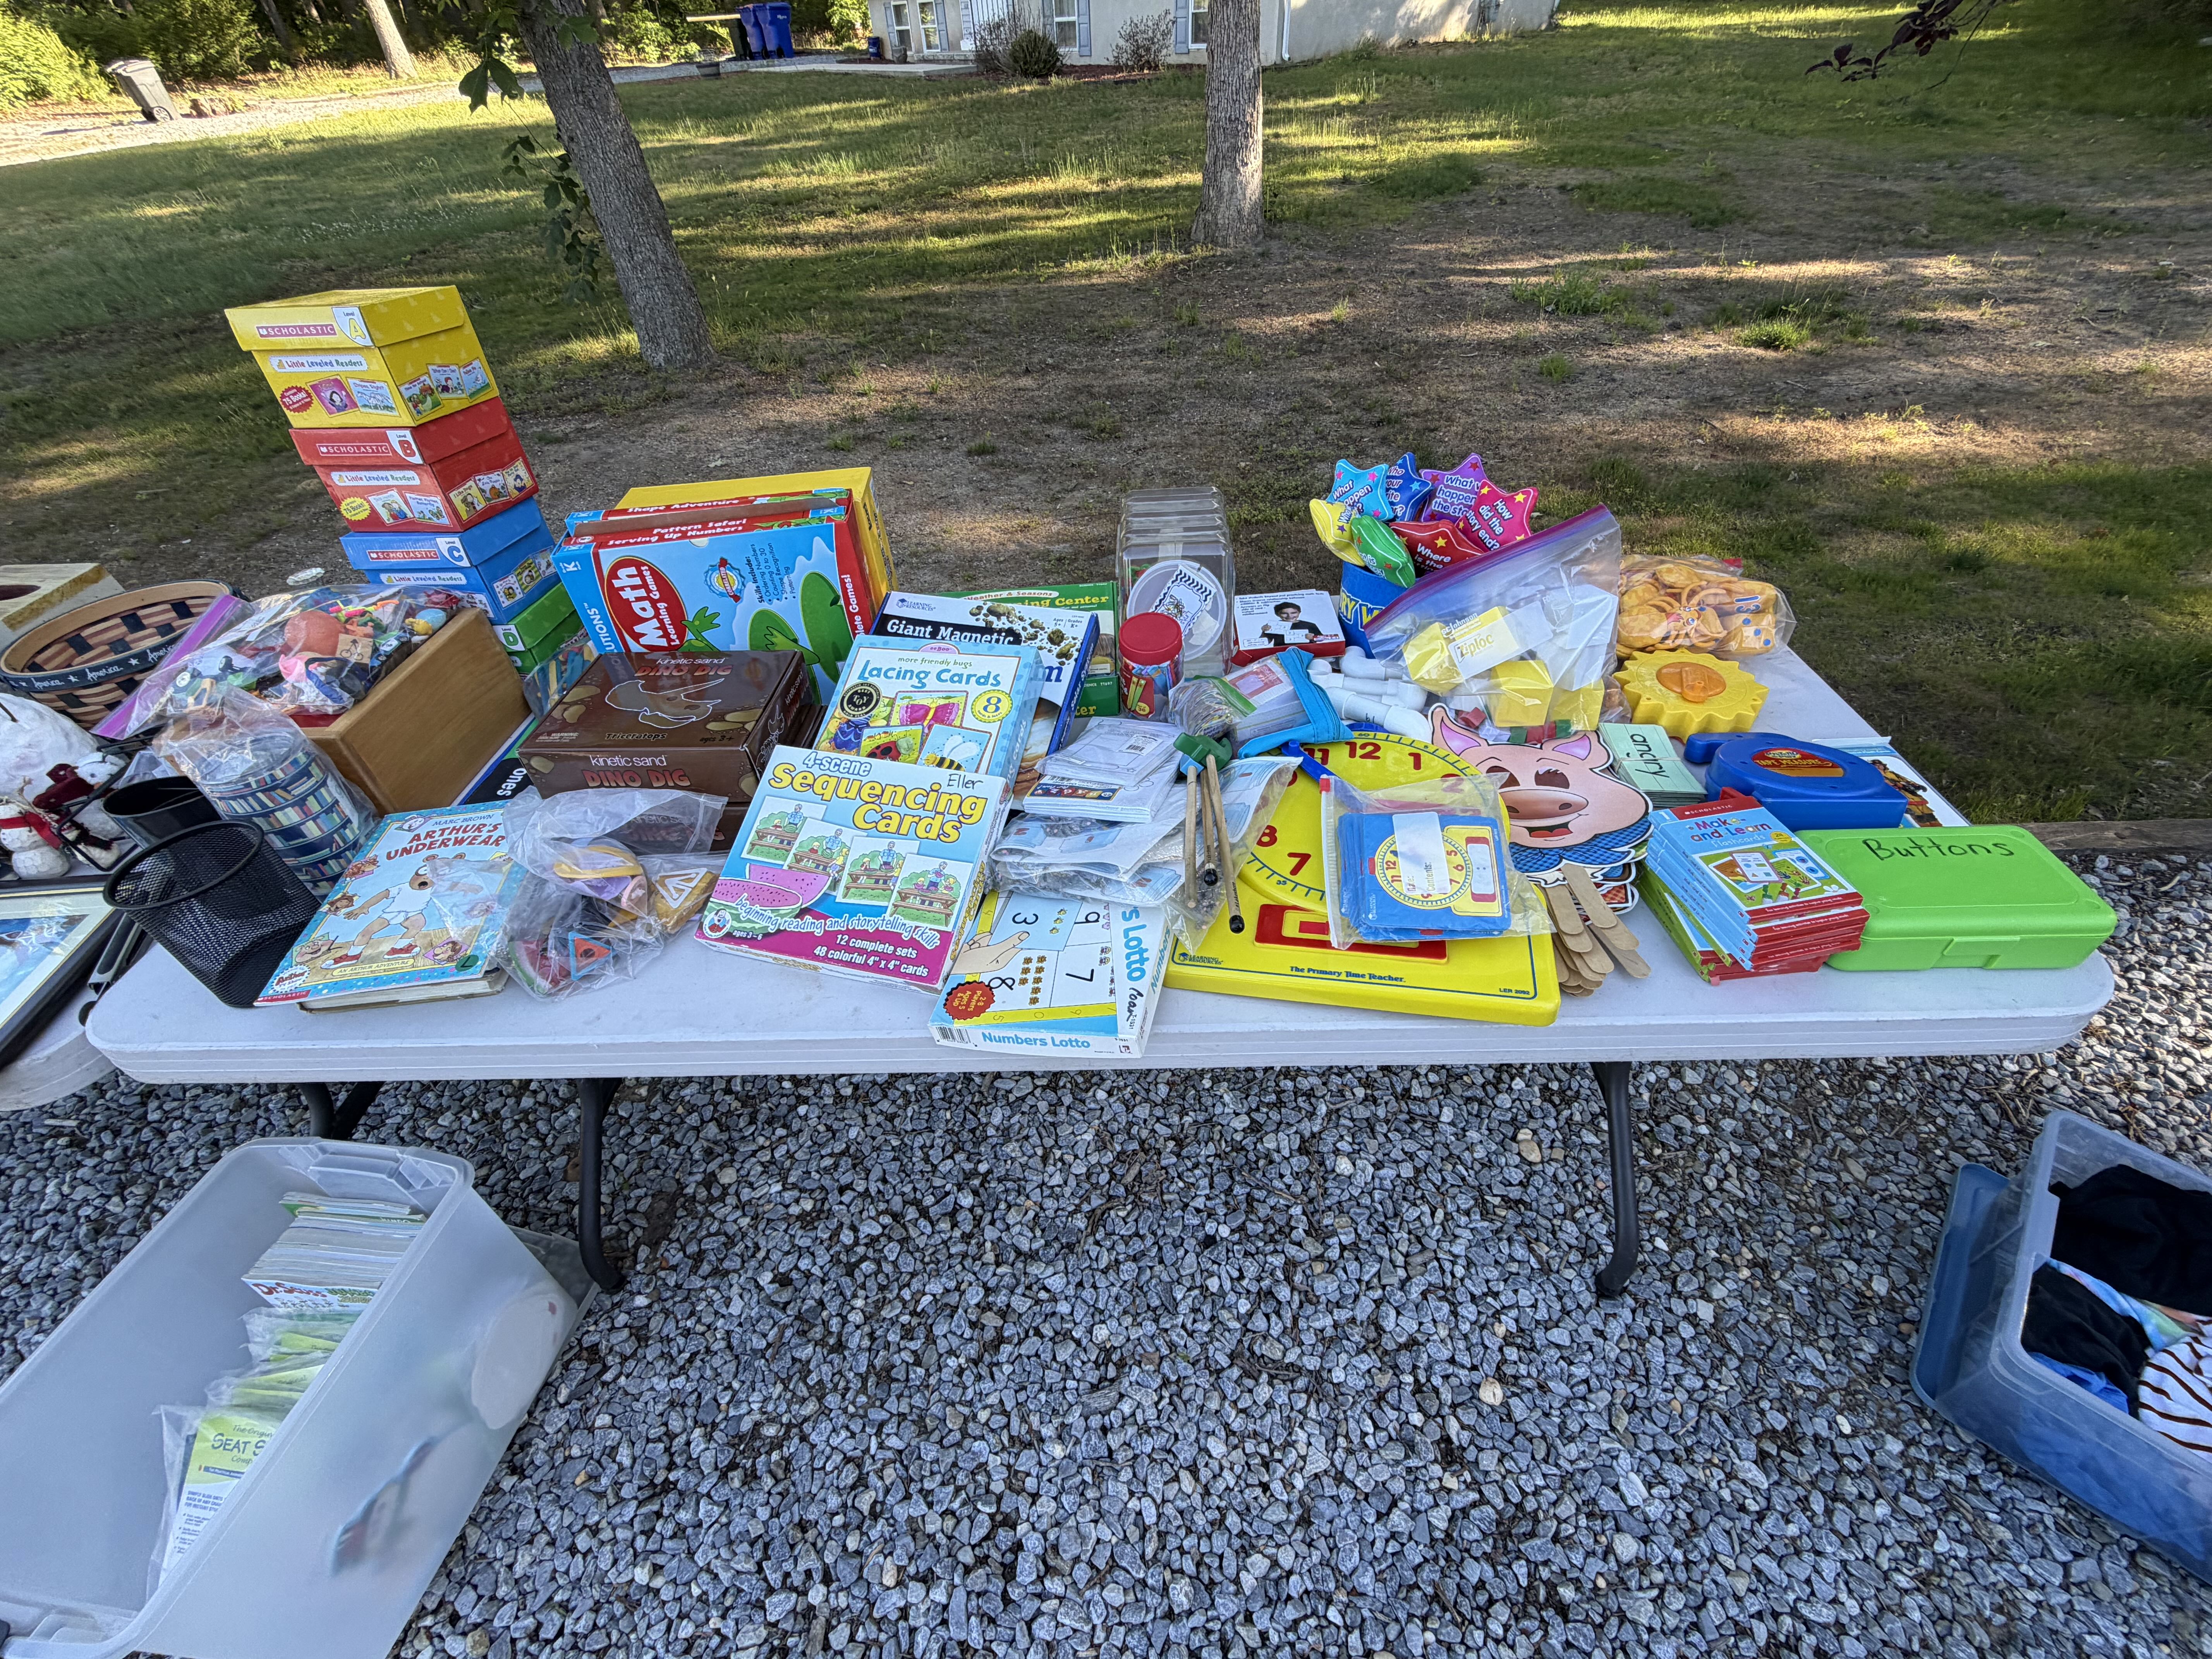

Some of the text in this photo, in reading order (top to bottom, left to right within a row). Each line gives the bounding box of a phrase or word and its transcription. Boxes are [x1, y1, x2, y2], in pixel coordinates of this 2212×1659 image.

[269, 326, 334, 335] SCHOLASTIC
[349, 318, 366, 339] A
[307, 359, 334, 368] Leveled
[335, 359, 363, 367] Readers
[282, 397, 291, 406] 75
[290, 390, 308, 402] Books!
[398, 440, 416, 457] B
[1332, 479, 1354, 500] What
[1444, 475, 1474, 489] What
[351, 502, 365, 512] Books!
[627, 499, 740, 513] Shape Adventure
[1432, 498, 1451, 512] the
[1493, 498, 1513, 521] How
[653, 519, 747, 534] Pattern Safari
[1479, 505, 1504, 536] did the
[607, 535, 659, 545] Serving
[687, 526, 743, 537] Numbers
[1466, 510, 1501, 551] story end?
[447, 546, 465, 562] C
[759, 548, 767, 556] 30
[768, 543, 781, 576] Recognition
[1417, 543, 1451, 562] Where
[750, 544, 771, 597] Ordering Numbers
[1414, 555, 1443, 569] is the
[745, 556, 765, 603] Skills Include:
[768, 571, 779, 596] Counting
[784, 566, 796, 594] Patterning
[841, 574, 858, 613] Games!
[1055, 596, 1109, 605] Center
[612, 566, 668, 647] Math
[641, 565, 680, 646] Learning Games
[503, 632, 519, 646] D
[887, 619, 1013, 645] Giant Magnetic
[1457, 633, 1495, 657] Ziploc
[634, 665, 732, 676] DINO DIG
[920, 658, 951, 667] friendly
[952, 656, 973, 668] bugs
[857, 659, 1001, 689] Lacing Cards
[853, 694, 869, 706] TOY
[983, 696, 1002, 713] 8
[1013, 720, 1027, 760] cards
[1345, 741, 1382, 760] 12
[589, 755, 668, 767] kinetic sand
[803, 751, 872, 777] 4-scene
[1408, 752, 1422, 771] 1
[582, 768, 691, 788] DINO DIG
[946, 774, 984, 790] Eller
[768, 763, 988, 824] Sequencing
[461, 814, 495, 823] BROWN
[1690, 805, 1733, 814] SCHOLASTIC
[852, 804, 962, 843] Cards
[1695, 817, 1746, 831] Make-
[407, 823, 503, 845] ARTHUR'S
[1711, 835, 1765, 847] Flashcards
[386, 835, 506, 860] UNDERWEAR
[1862, 836, 2015, 861] Buttons
[1287, 852, 1312, 876] 7
[1385, 860, 1397, 871] 12
[1422, 862, 1436, 891] Contents:
[734, 894, 779, 933] beginning
[780, 917, 823, 934] reading
[826, 915, 847, 930] and
[850, 914, 914, 938] storytelling
[914, 927, 940, 949] skills
[1012, 912, 1039, 925] 3
[732, 930, 747, 939] ages
[836, 934, 918, 959] 12 complete sets
[1123, 924, 1150, 982] Lotto
[375, 960, 410, 969] ADVENTURE
[814, 946, 826, 957] 48
[828, 950, 866, 965] colorful
[867, 956, 879, 967] 4"
[879, 960, 886, 969] x
[887, 960, 900, 970] 4"
[900, 963, 929, 977] cards
[1150, 925, 1170, 994] Numbers
[1065, 969, 1094, 982] 7
[1307, 968, 1342, 977] Primary
[1345, 970, 1366, 979] Time
[1369, 972, 1406, 982] Teacher
[263, 991, 307, 1000] SCHOLASTIC
[953, 998, 960, 1006] Up
[962, 991, 972, 1005] Ages
[968, 990, 982, 1011] Players
[982, 1032, 1091, 1049] Numbers Lotto
[252, 1283, 283, 1296] Dr.
[275, 1282, 328, 1297] Seuss
[211, 1433, 251, 1454] SEAT
